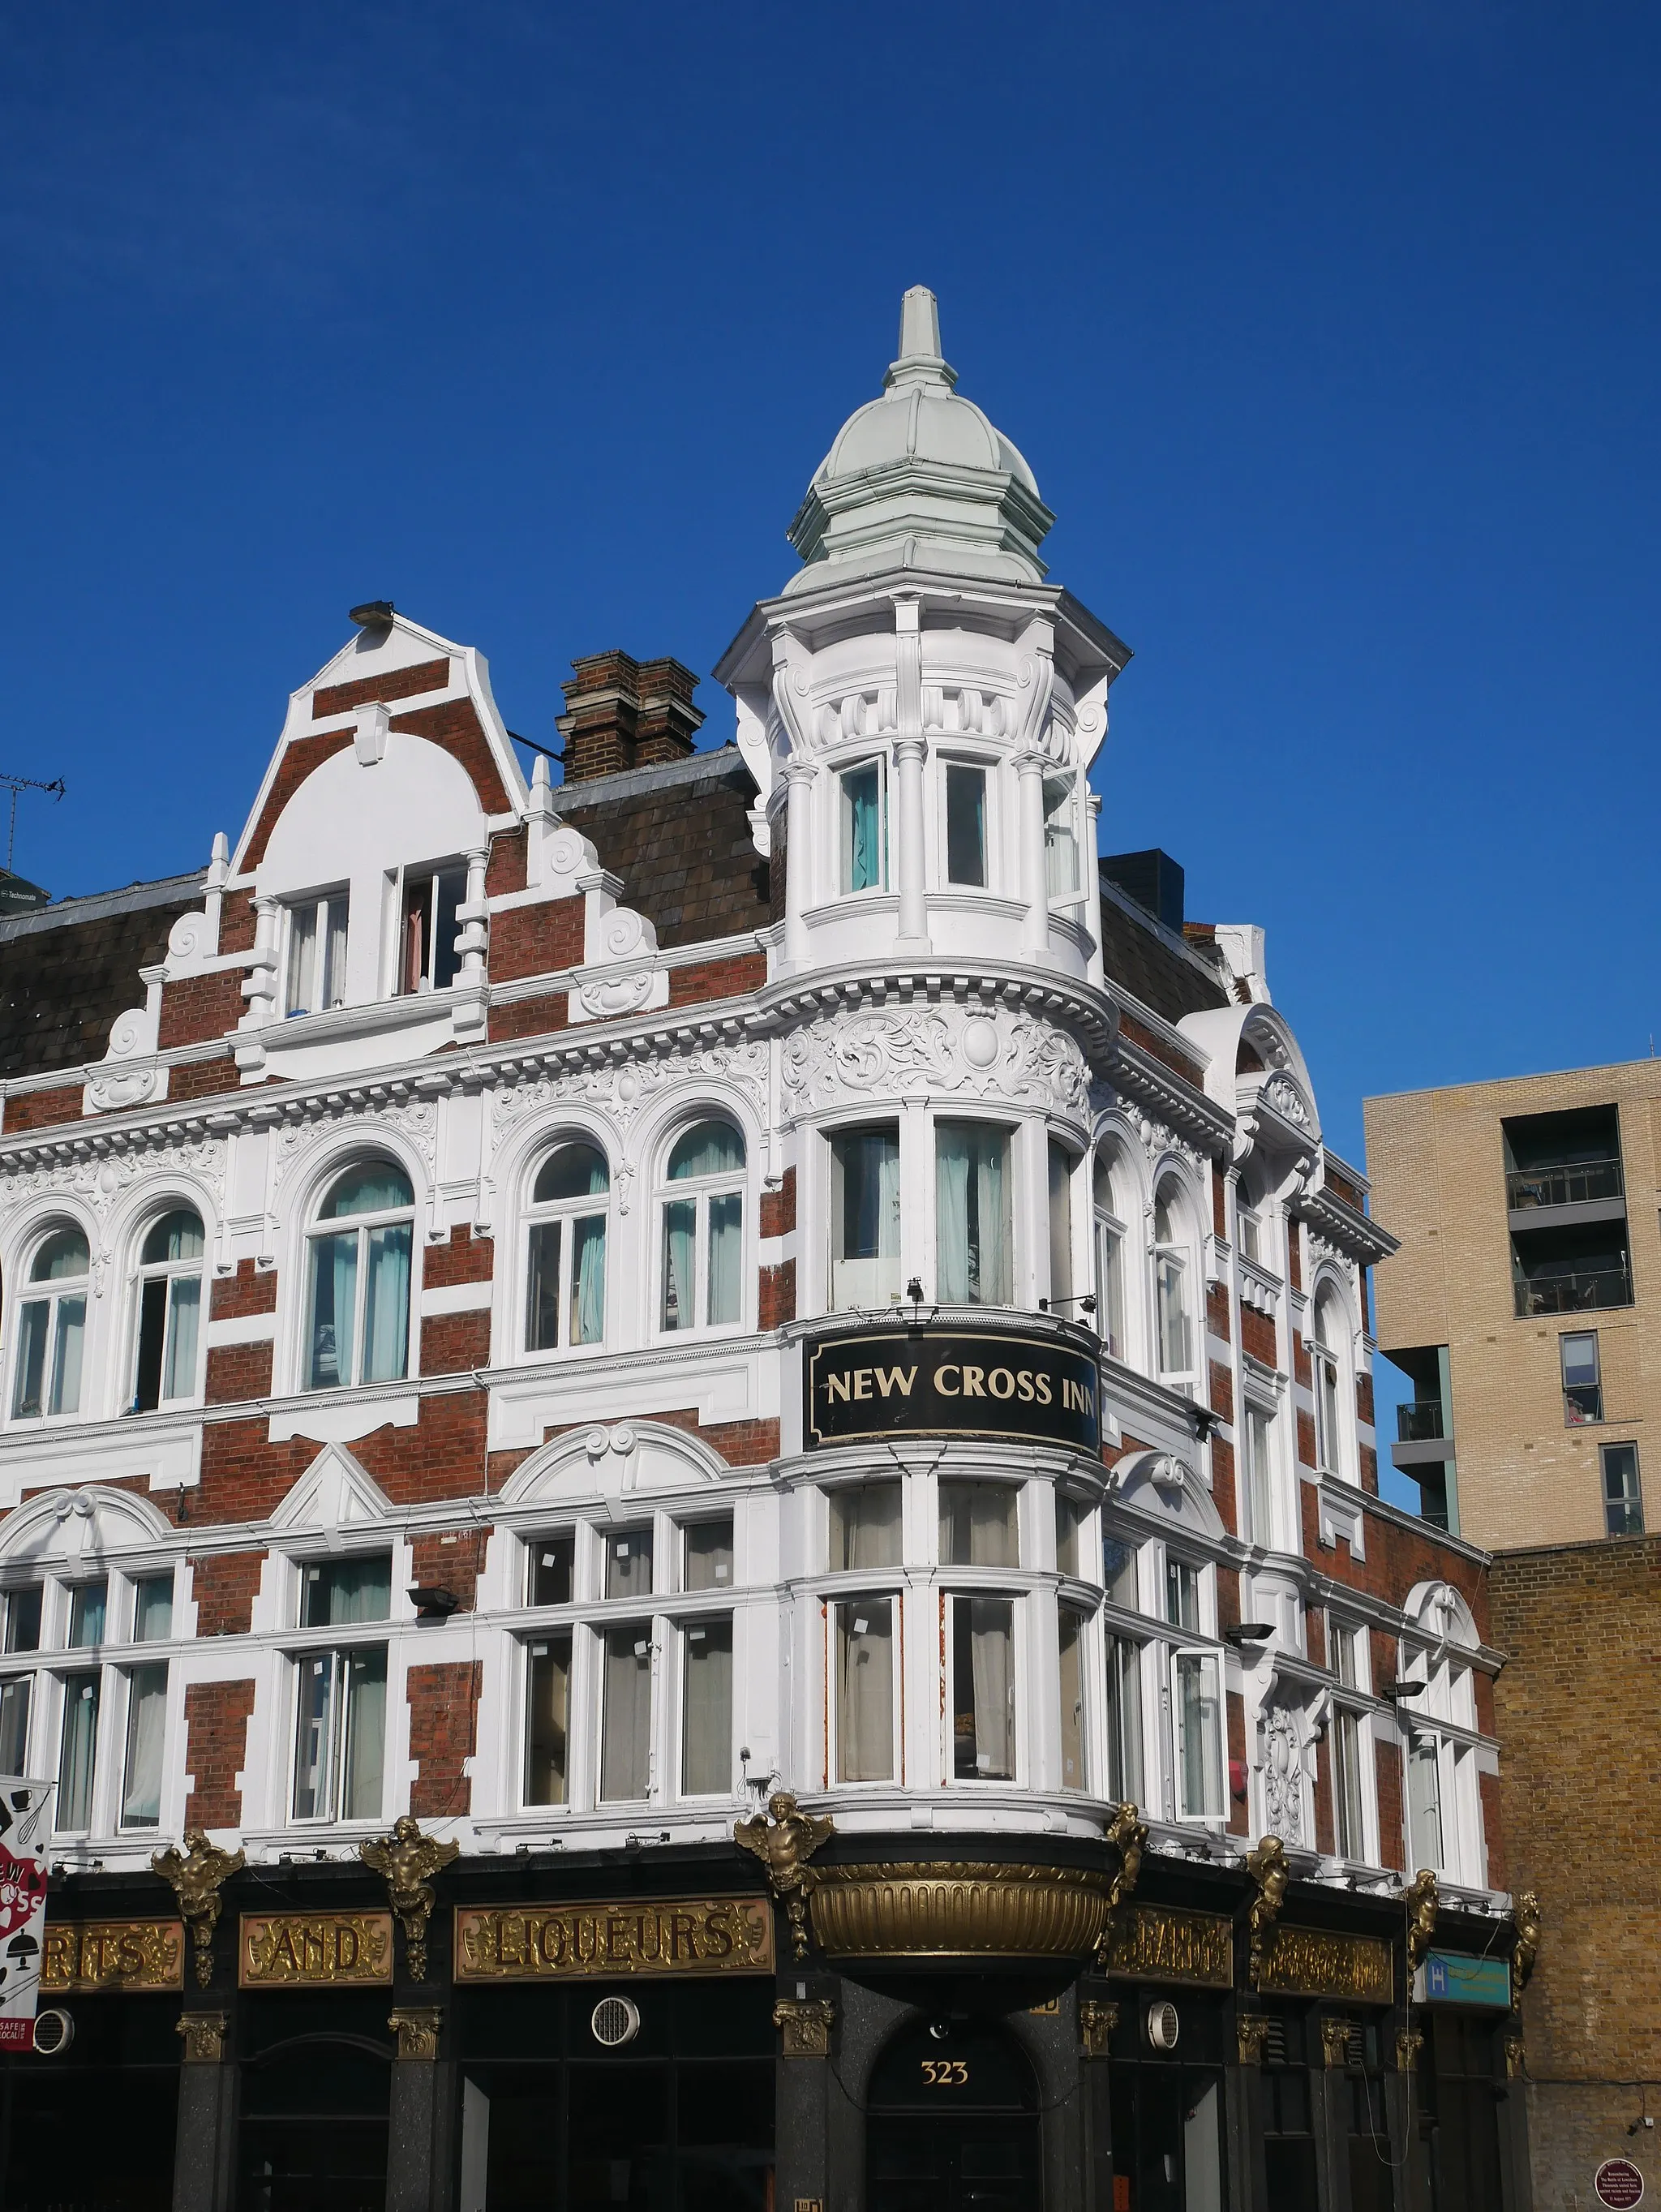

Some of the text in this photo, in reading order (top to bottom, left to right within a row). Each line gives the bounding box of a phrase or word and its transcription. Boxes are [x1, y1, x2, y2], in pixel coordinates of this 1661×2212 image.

[827, 1364, 1095, 1418] NEW CROSS INN
[269, 1926, 359, 1971] AND
[496, 1913, 734, 1966] LIQUEURS
[0, 2031, 18, 2039] OCAL
[921, 2061, 968, 2084] 323
